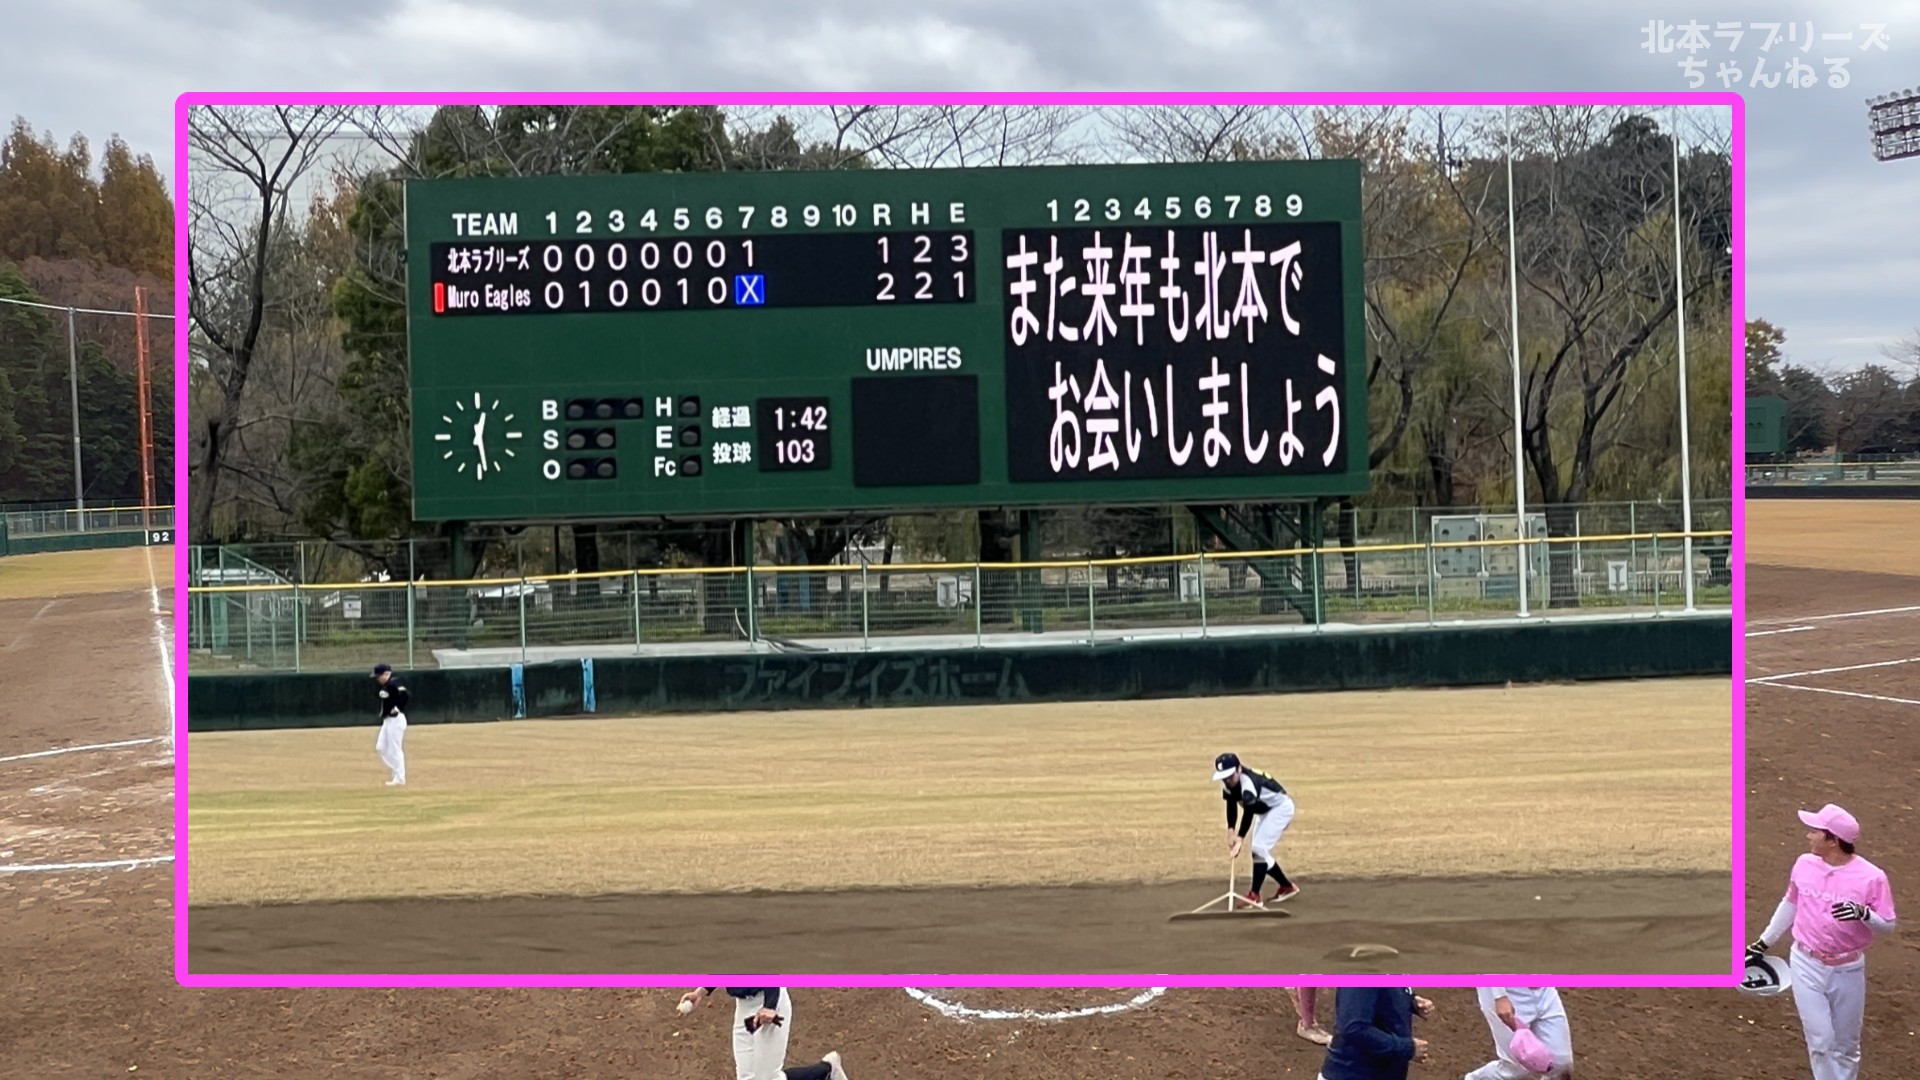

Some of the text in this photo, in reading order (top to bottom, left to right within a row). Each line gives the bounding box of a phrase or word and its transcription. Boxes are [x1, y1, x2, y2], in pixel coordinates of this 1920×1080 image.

[452, 202, 965, 236] TEAM 1 2 3 4 5 6 7 8 9 10 R H E
[1047, 194, 1302, 221] 1 2 3 4 5 6 7 8 9
[447, 246, 530, 273] 北本ラブリーズ
[544, 235, 968, 272] 0 0 0 0 0 0 1 1 2 3
[448, 283, 531, 311] Muro Eagles
[545, 271, 964, 308] 0 1 0 0 1 0 X 2 2 1
[1007, 228, 1303, 346] また来年も北本で
[866, 347, 961, 371] UMPIRES
[542, 400, 558, 421] B
[656, 397, 672, 417] H
[712, 406, 751, 428] 経過
[774, 406, 828, 431] 1:42
[1048, 353, 1340, 473] お会いしましょう
[543, 430, 559, 450] S
[656, 426, 673, 448] E
[713, 442, 751, 464] 投球
[775, 439, 815, 463] 103
[543, 460, 561, 480] O
[654, 457, 676, 477] Fc
[152, 531, 170, 543] 92
